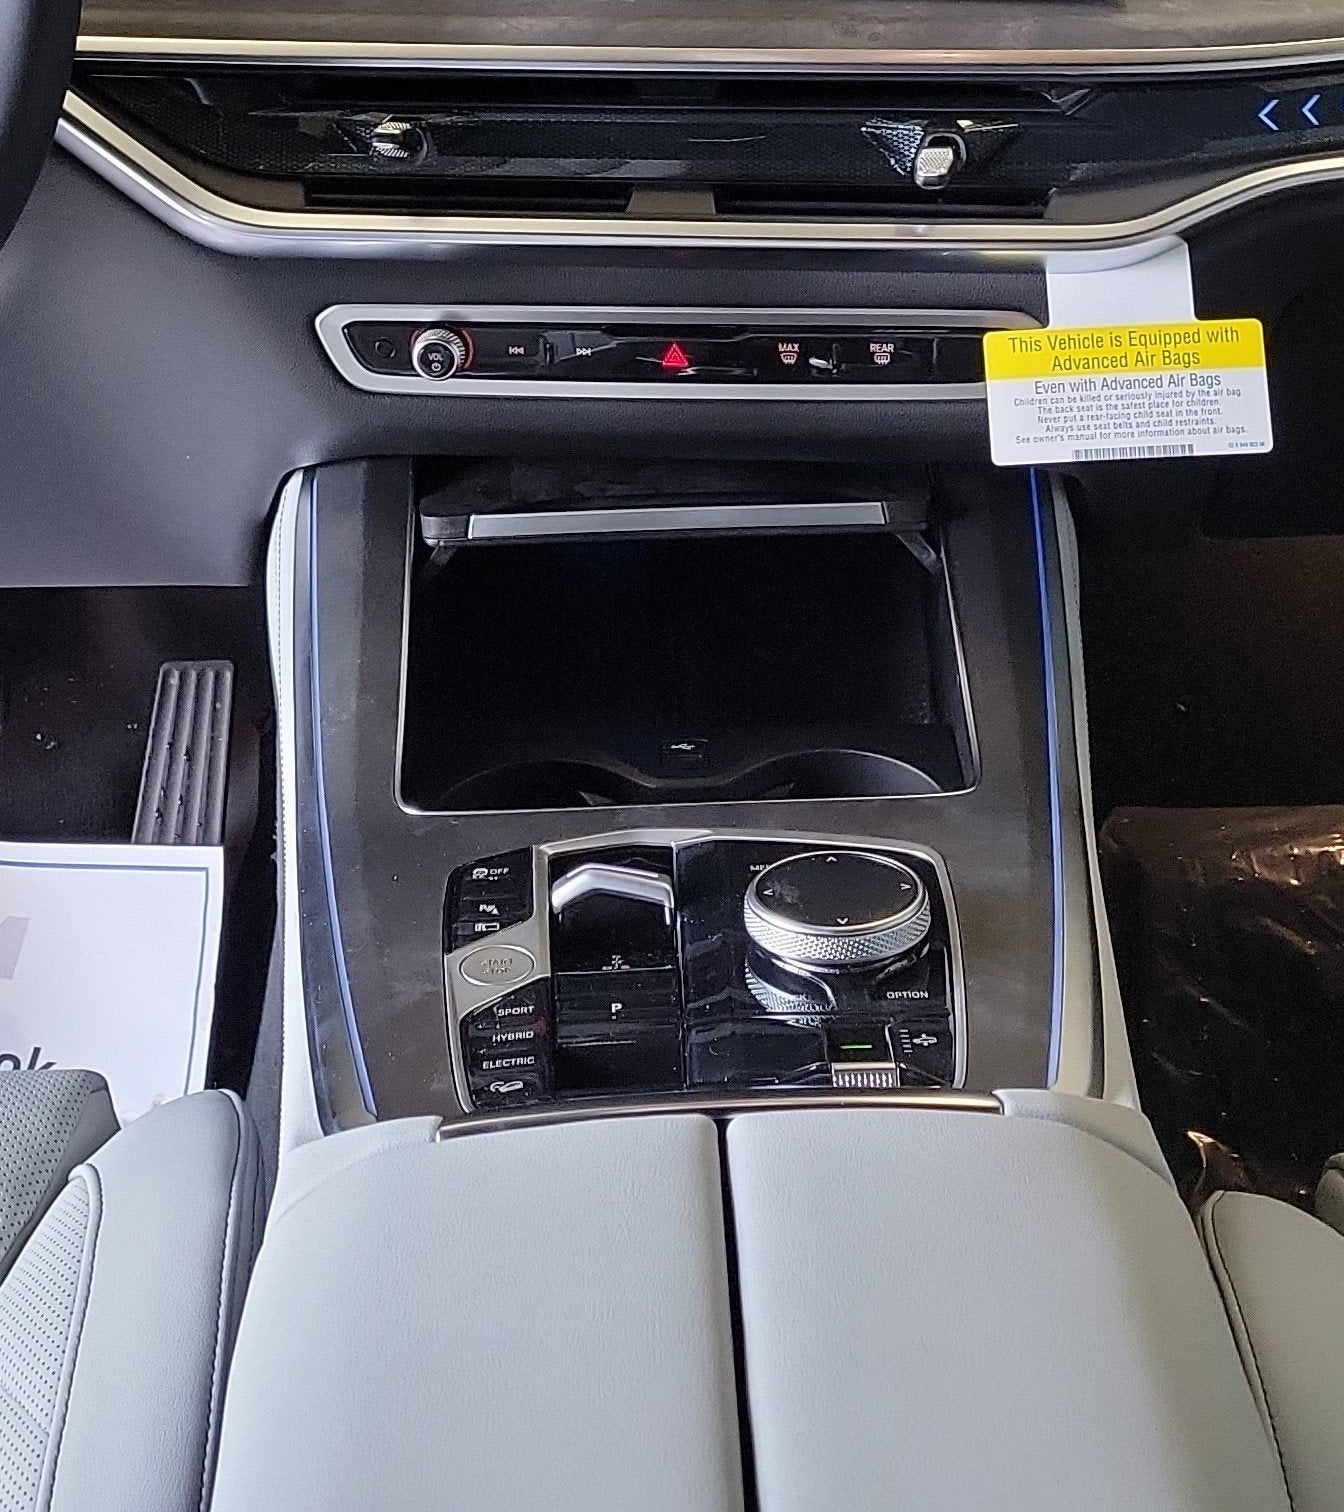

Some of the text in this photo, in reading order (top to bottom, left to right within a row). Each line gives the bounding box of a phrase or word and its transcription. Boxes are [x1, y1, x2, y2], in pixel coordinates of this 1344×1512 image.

[1008, 326, 1240, 354] This Vehicle is Equipped with
[778, 343, 799, 352] MAX
[869, 343, 894, 353] REAR
[428, 352, 443, 361] VOL
[1052, 349, 1201, 371] Advanced Air Bags
[1035, 372, 1222, 395] Even with Advanced Air Bags
[1014, 398, 1048, 406] Children
[1050, 397, 1065, 405] can
[1080, 394, 1101, 402] killed
[1104, 393, 1113, 401] or
[1115, 391, 1152, 401] seriously
[1155, 390, 1183, 400] injured
[1186, 390, 1196, 399] by
[1198, 389, 1211, 397] the
[1213, 389, 1224, 397] air
[1226, 388, 1241, 397] bag
[1038, 406, 1052, 414] The
[1055, 405, 1074, 413] back
[1077, 404, 1094, 412] seat
[1106, 402, 1119, 411] the
[1121, 401, 1146, 410] safest
[1148, 400, 1169, 410] place
[1172, 399, 1183, 407] for
[1038, 415, 1060, 423] Never
[1063, 414, 1077, 424] put
[1087, 411, 1131, 421] rear-facing
[1134, 410, 1154, 419] child
[1156, 409, 1173, 418] seat
[1186, 408, 1199, 416] the
[1046, 424, 1074, 433] Always
[1077, 423, 1091, 431] use
[1094, 422, 1111, 431] seat
[1113, 421, 1133, 430] belts
[1136, 420, 1151, 429] and
[1153, 419, 1173, 427] child
[1016, 435, 1031, 444] See
[1033, 433, 1065, 443] owner's
[1067, 432, 1097, 441] manual
[1099, 431, 1111, 439] for
[1114, 430, 1135, 439] more
[1137, 428, 1185, 438] information
[1187, 427, 1211, 436] about
[1213, 426, 1224, 434] air
[489, 867, 510, 875] OFF
[886, 991, 929, 999] OPTION
[497, 1005, 535, 1016] SPORT
[492, 1031, 534, 1042] HYBRID
[482, 1056, 535, 1069] ELECTRIC
